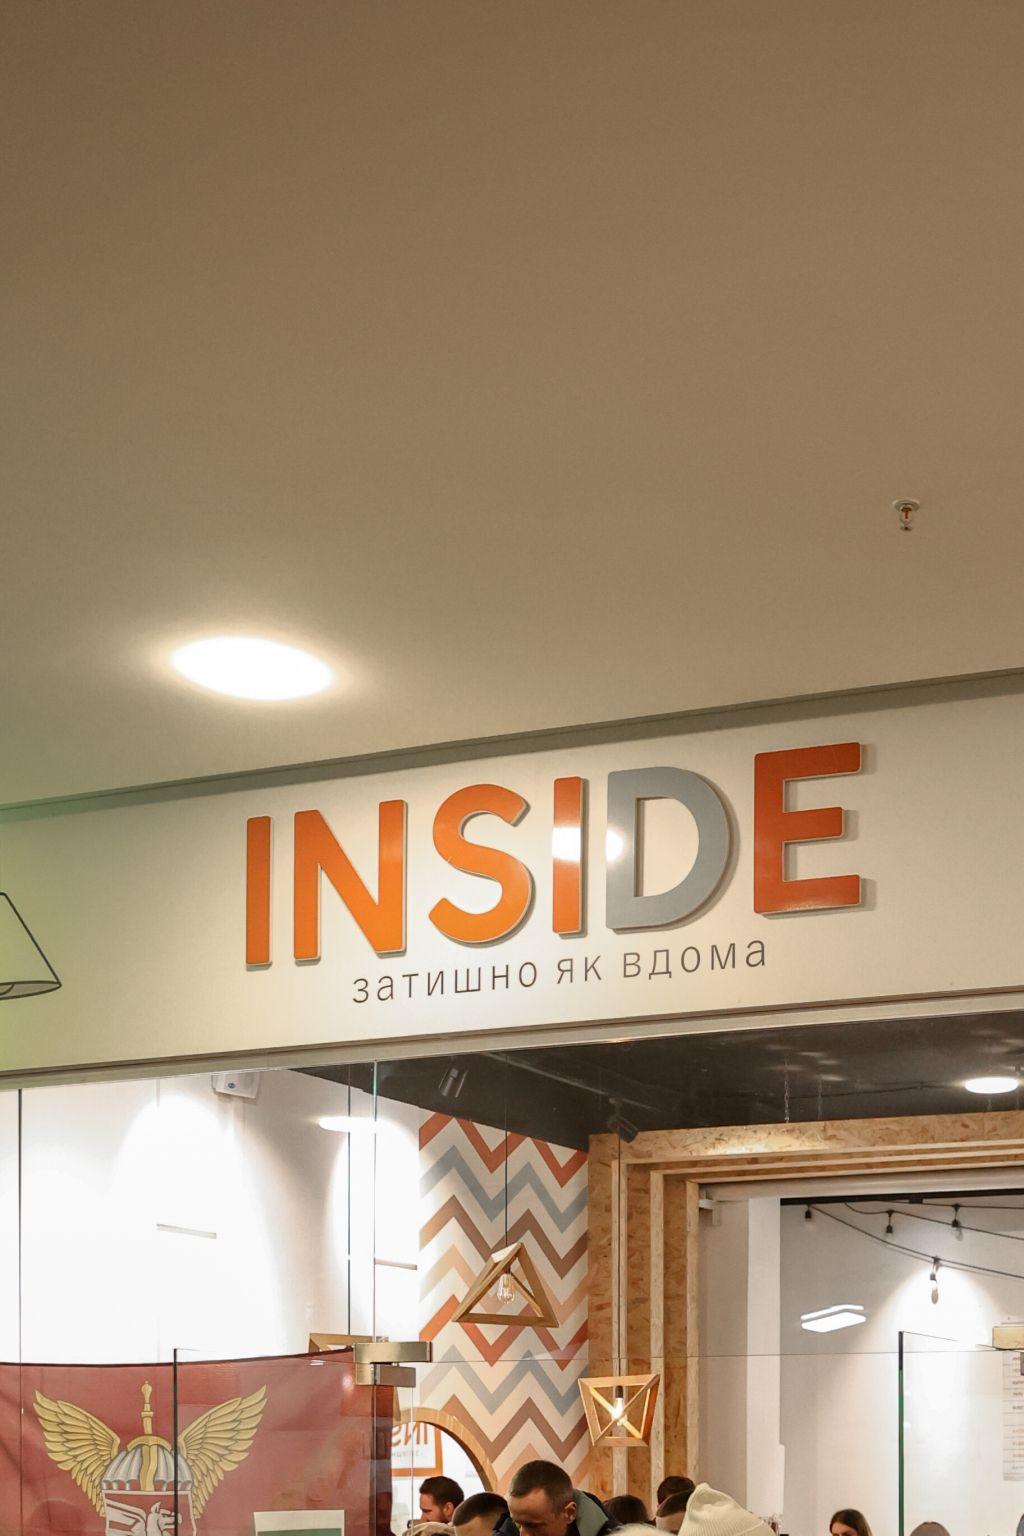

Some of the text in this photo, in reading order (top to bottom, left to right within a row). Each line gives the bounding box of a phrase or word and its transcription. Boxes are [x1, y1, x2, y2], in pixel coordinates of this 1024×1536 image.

[246, 741, 864, 967] INSIDE
[352, 938, 767, 1004] затишно як вдома
